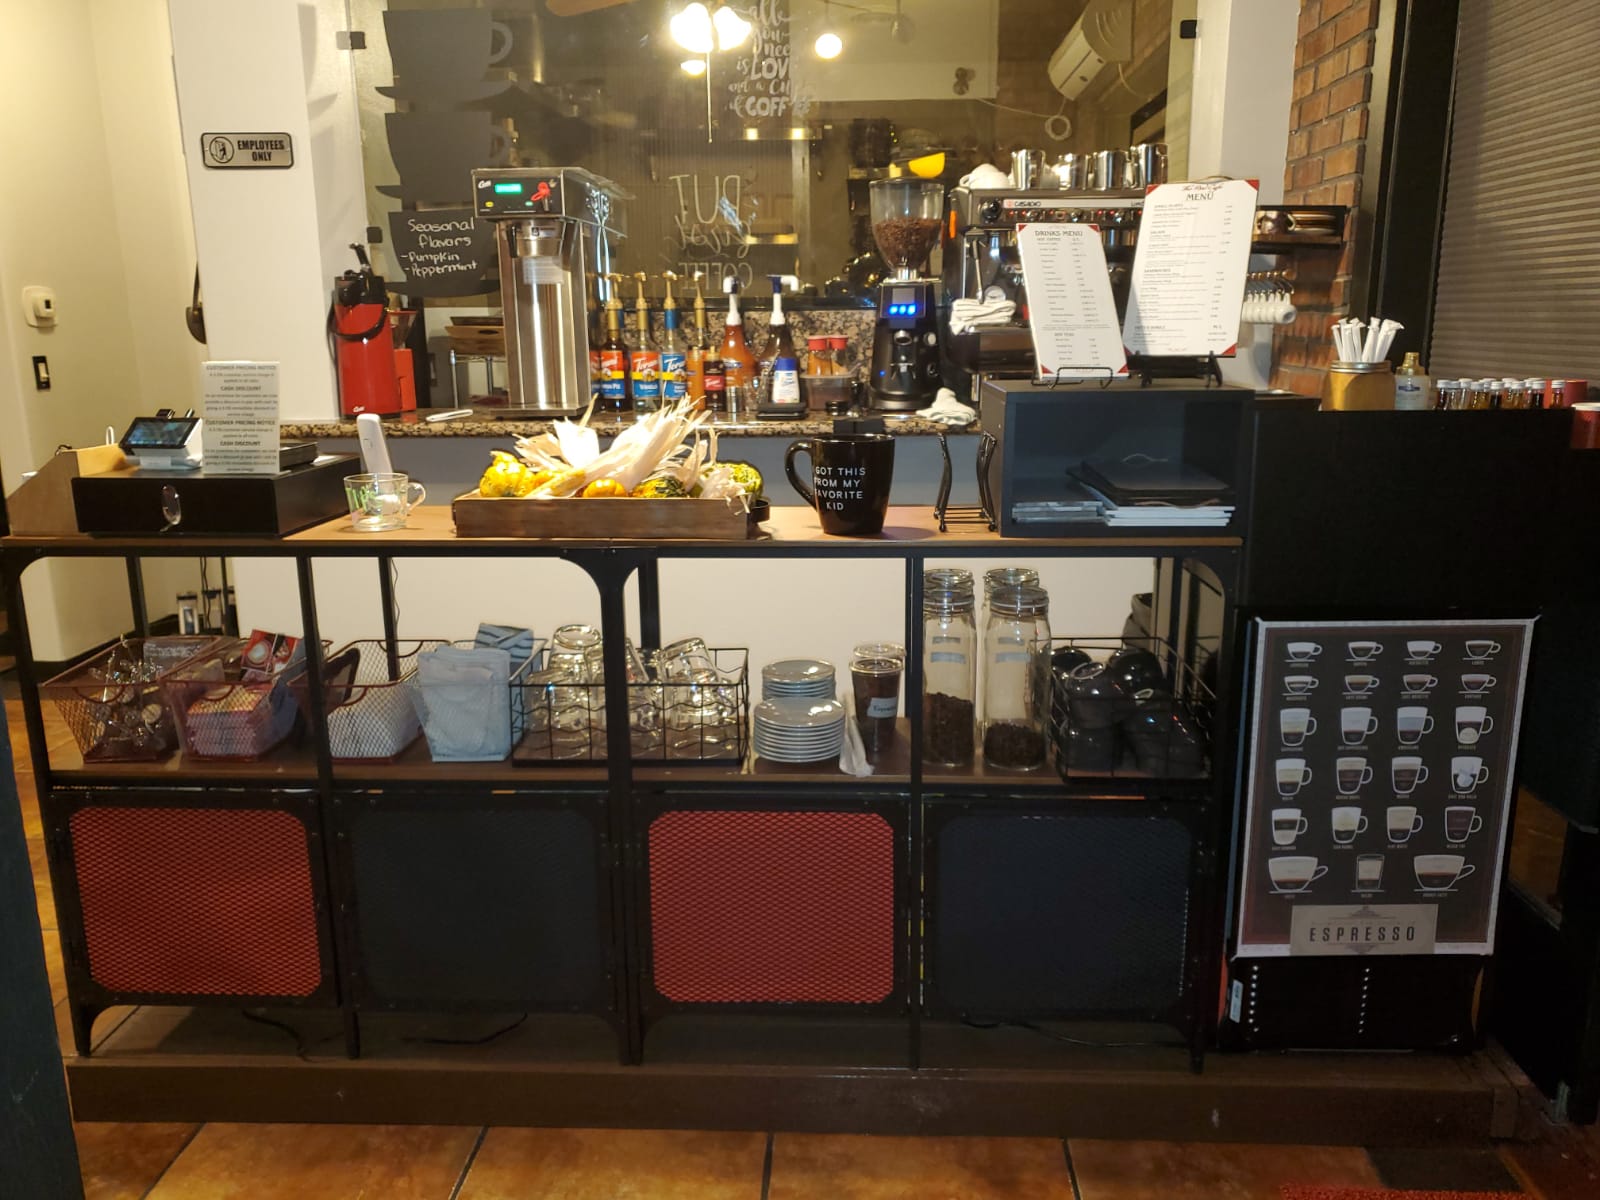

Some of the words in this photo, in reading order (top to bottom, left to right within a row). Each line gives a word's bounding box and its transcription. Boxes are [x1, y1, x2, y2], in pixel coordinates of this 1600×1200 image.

[763, 42, 793, 58] nee
[751, 57, 793, 80] LOV
[237, 139, 285, 150] EMPLOYEES
[252, 151, 272, 161] ONLY
[1185, 192, 1214, 201] MENU
[407, 216, 475, 232] Seasonal
[815, 466, 833, 476] GOT
[838, 467, 866, 476] THIS
[814, 476, 838, 488] FROM
[843, 479, 861, 488] MY
[815, 488, 864, 499] FAVORITE
[826, 501, 844, 511] KID
[1309, 926, 1415, 942] ESPRESSO
